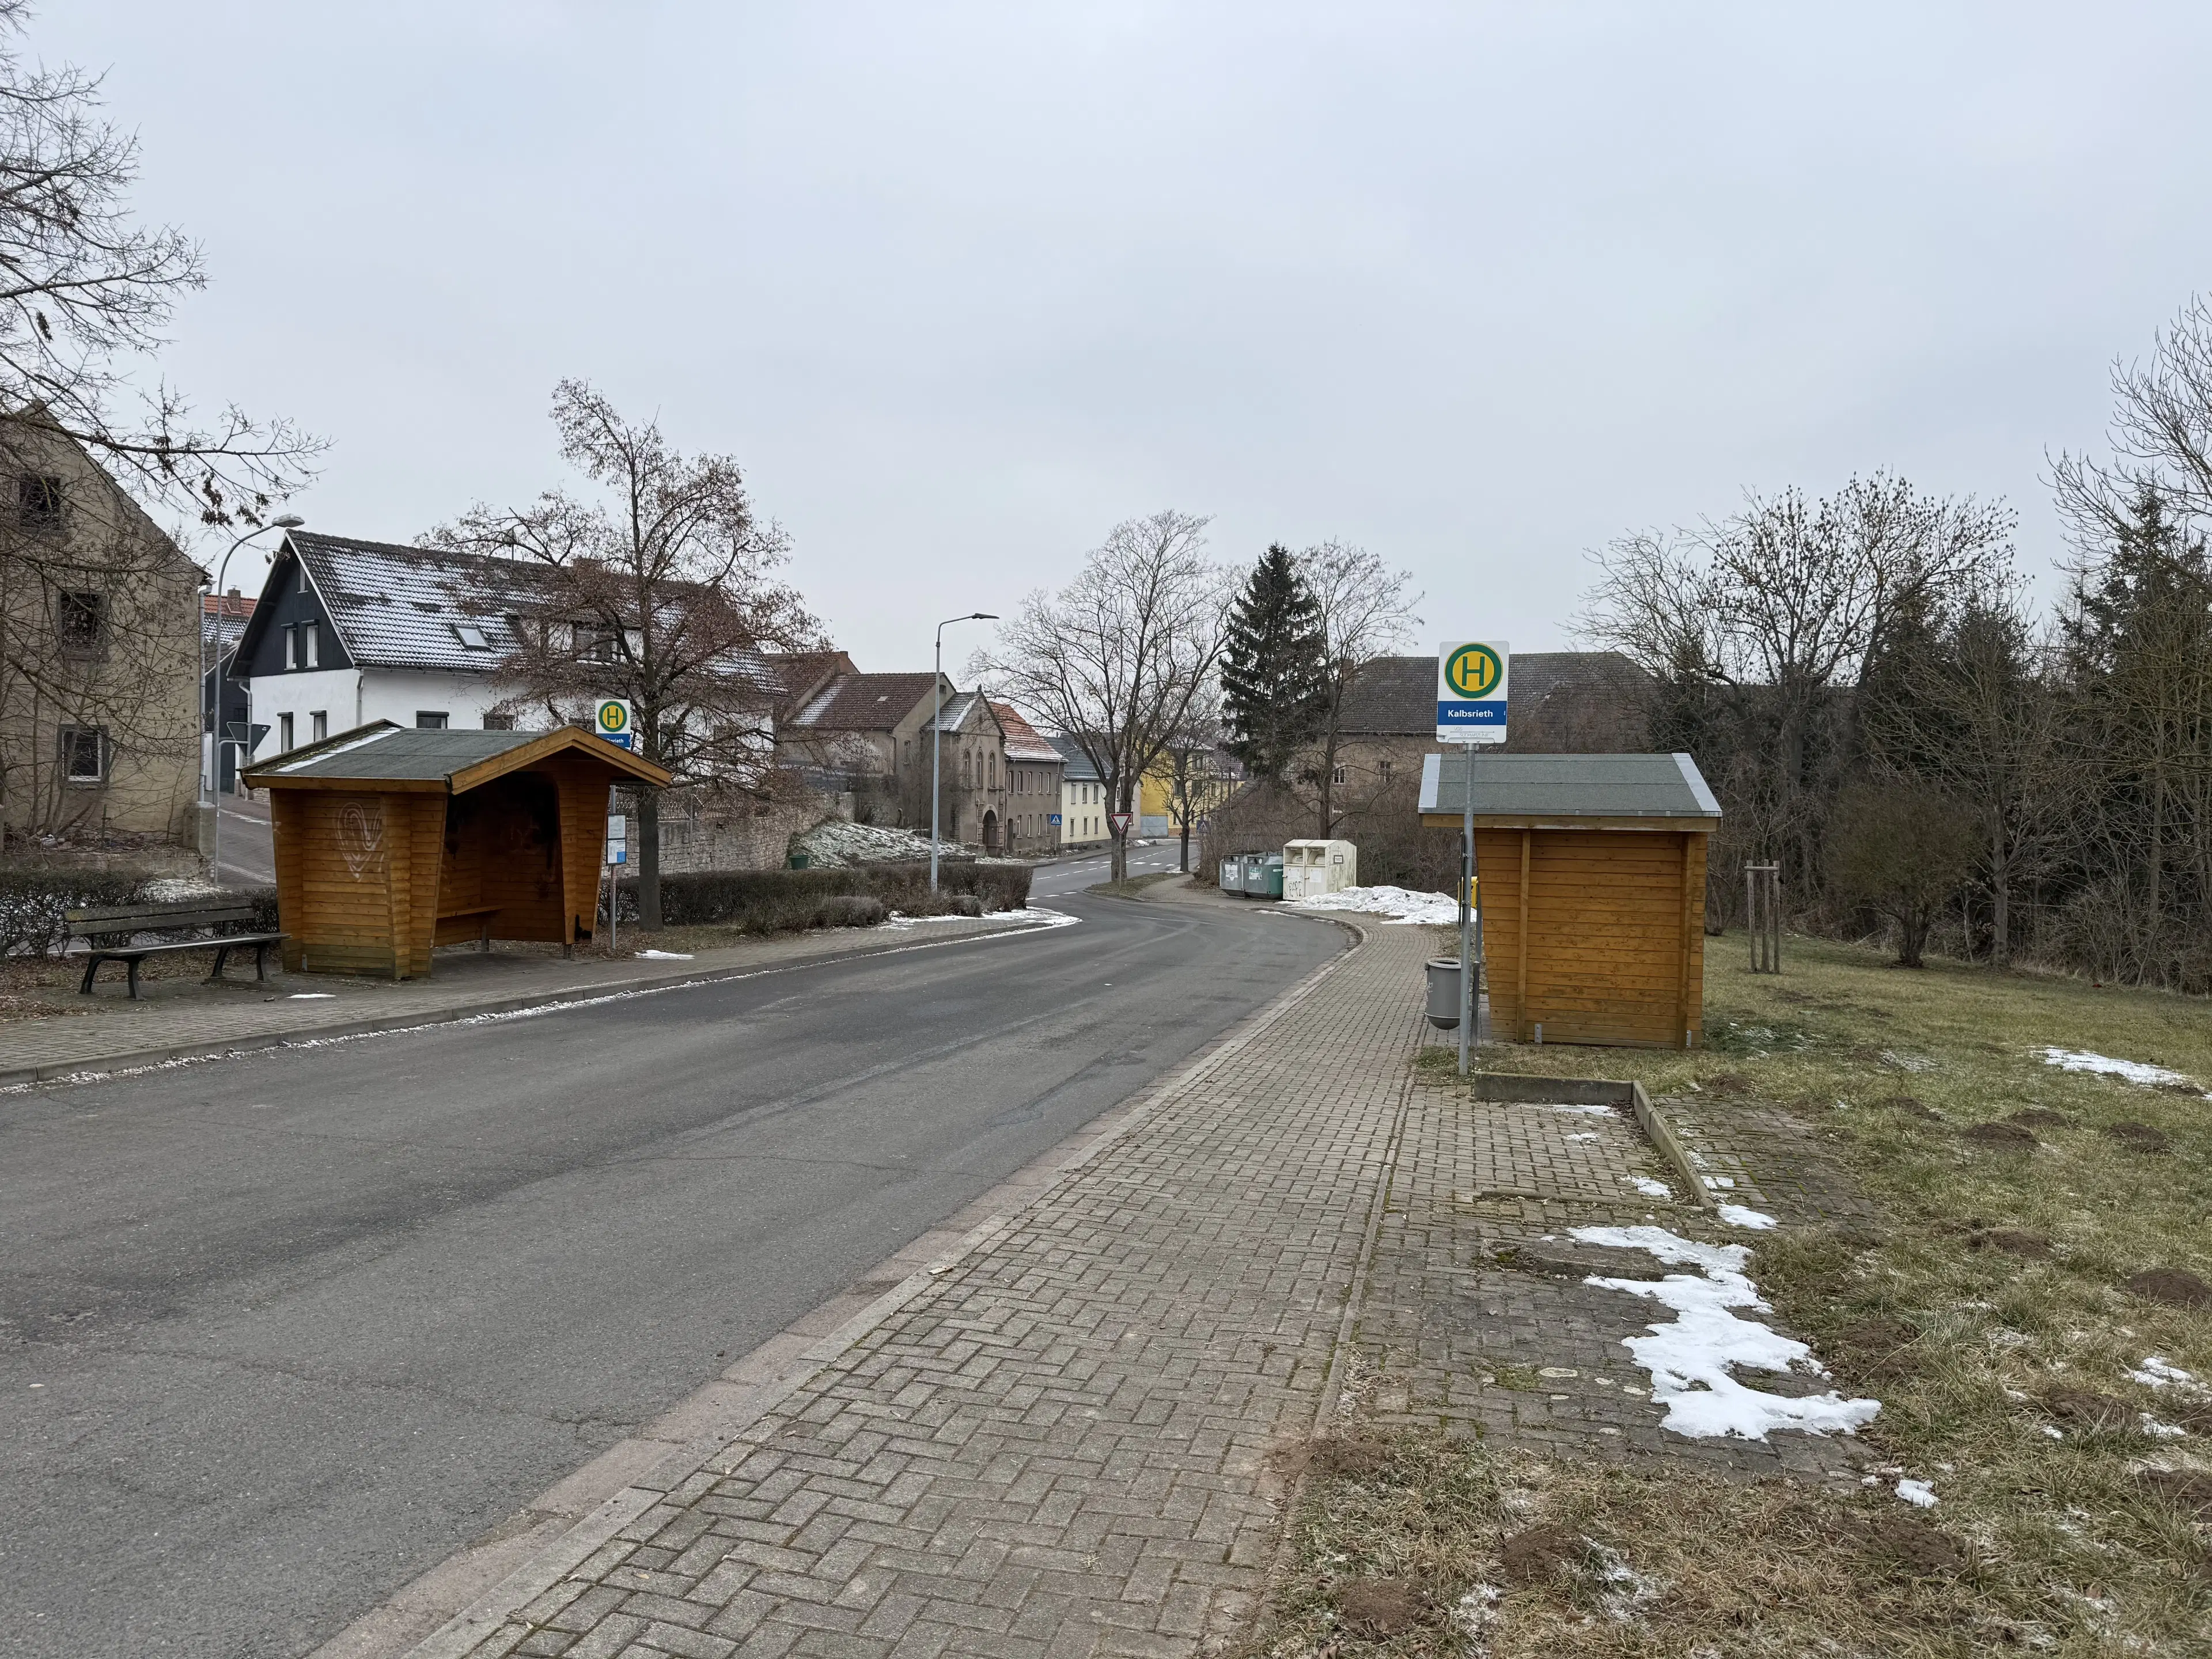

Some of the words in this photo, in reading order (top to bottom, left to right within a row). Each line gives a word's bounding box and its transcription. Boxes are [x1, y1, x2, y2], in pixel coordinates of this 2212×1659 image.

[1461, 656, 1485, 686] H
[607, 708, 619, 725] H
[1448, 709, 1493, 718] Kalbsrieth
